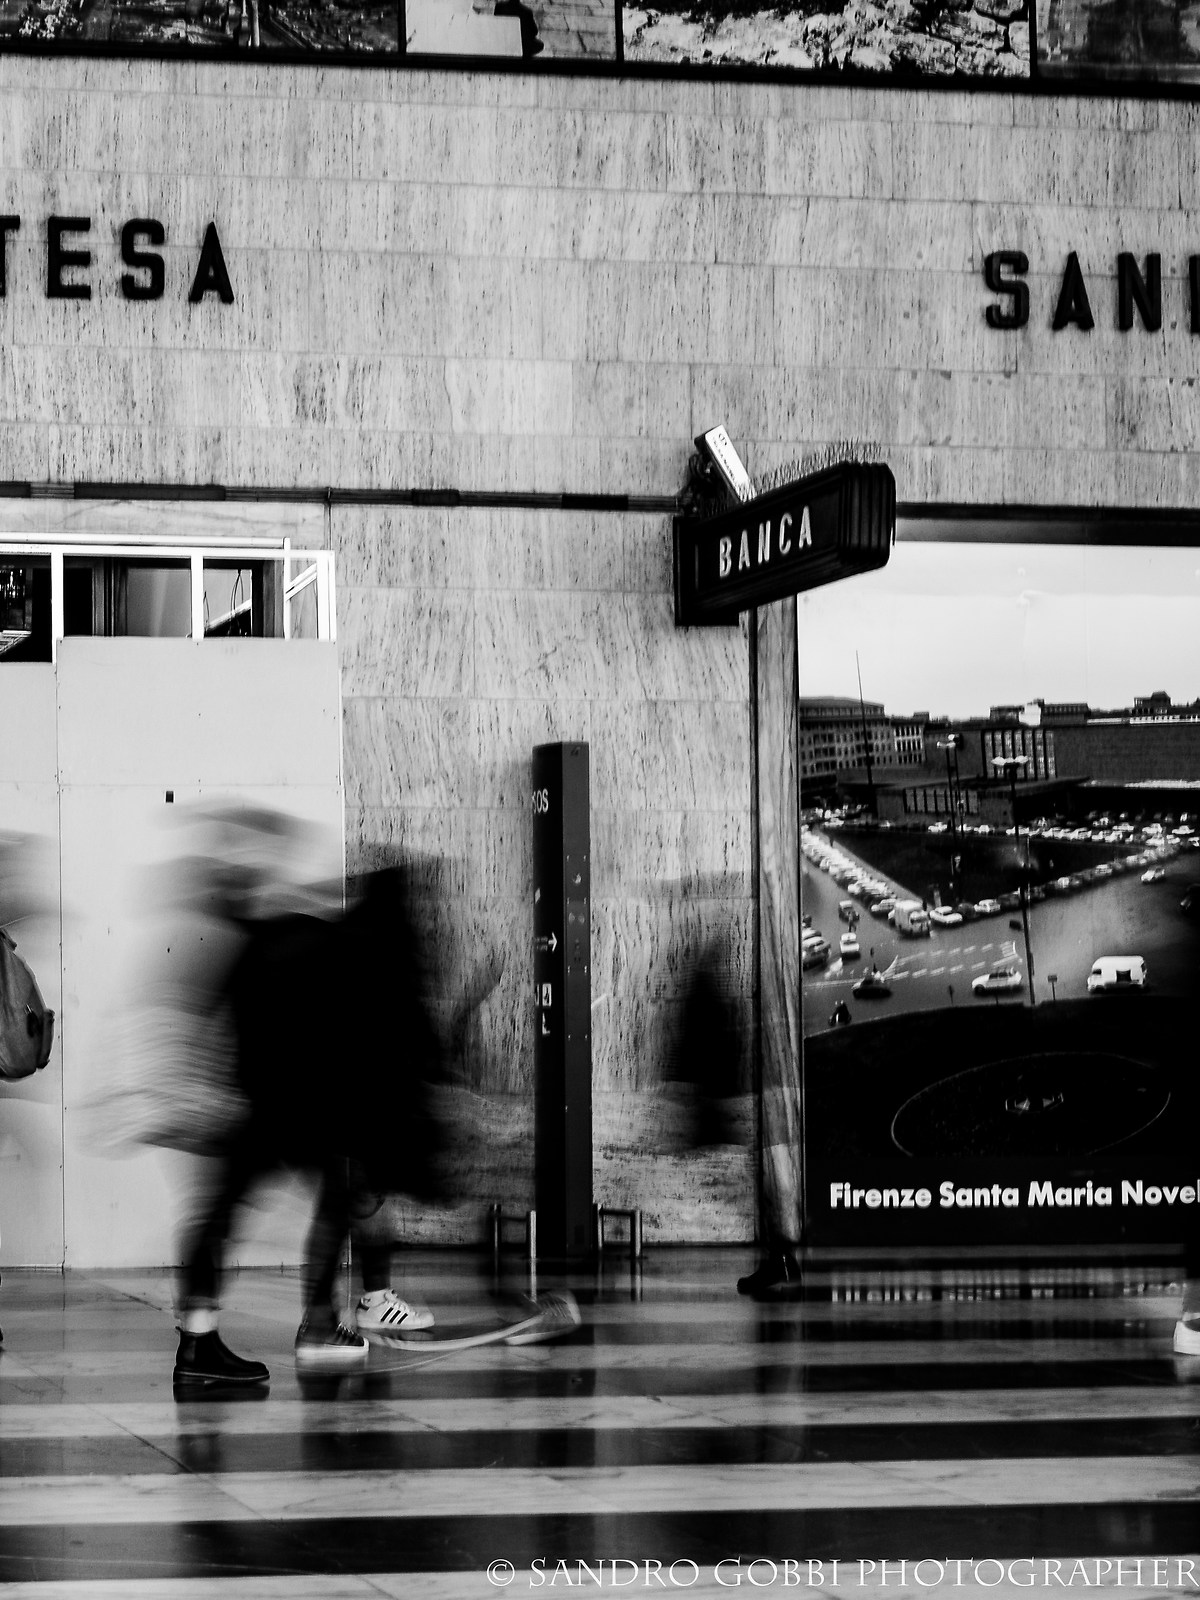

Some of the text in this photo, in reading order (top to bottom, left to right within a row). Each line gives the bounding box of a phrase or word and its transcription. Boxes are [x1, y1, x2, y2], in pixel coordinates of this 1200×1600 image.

[719, 505, 812, 578] BANCA
[830, 1181, 932, 1208] Firenze
[939, 1181, 1019, 1207] Santa
[1027, 1180, 1113, 1207] Maria
